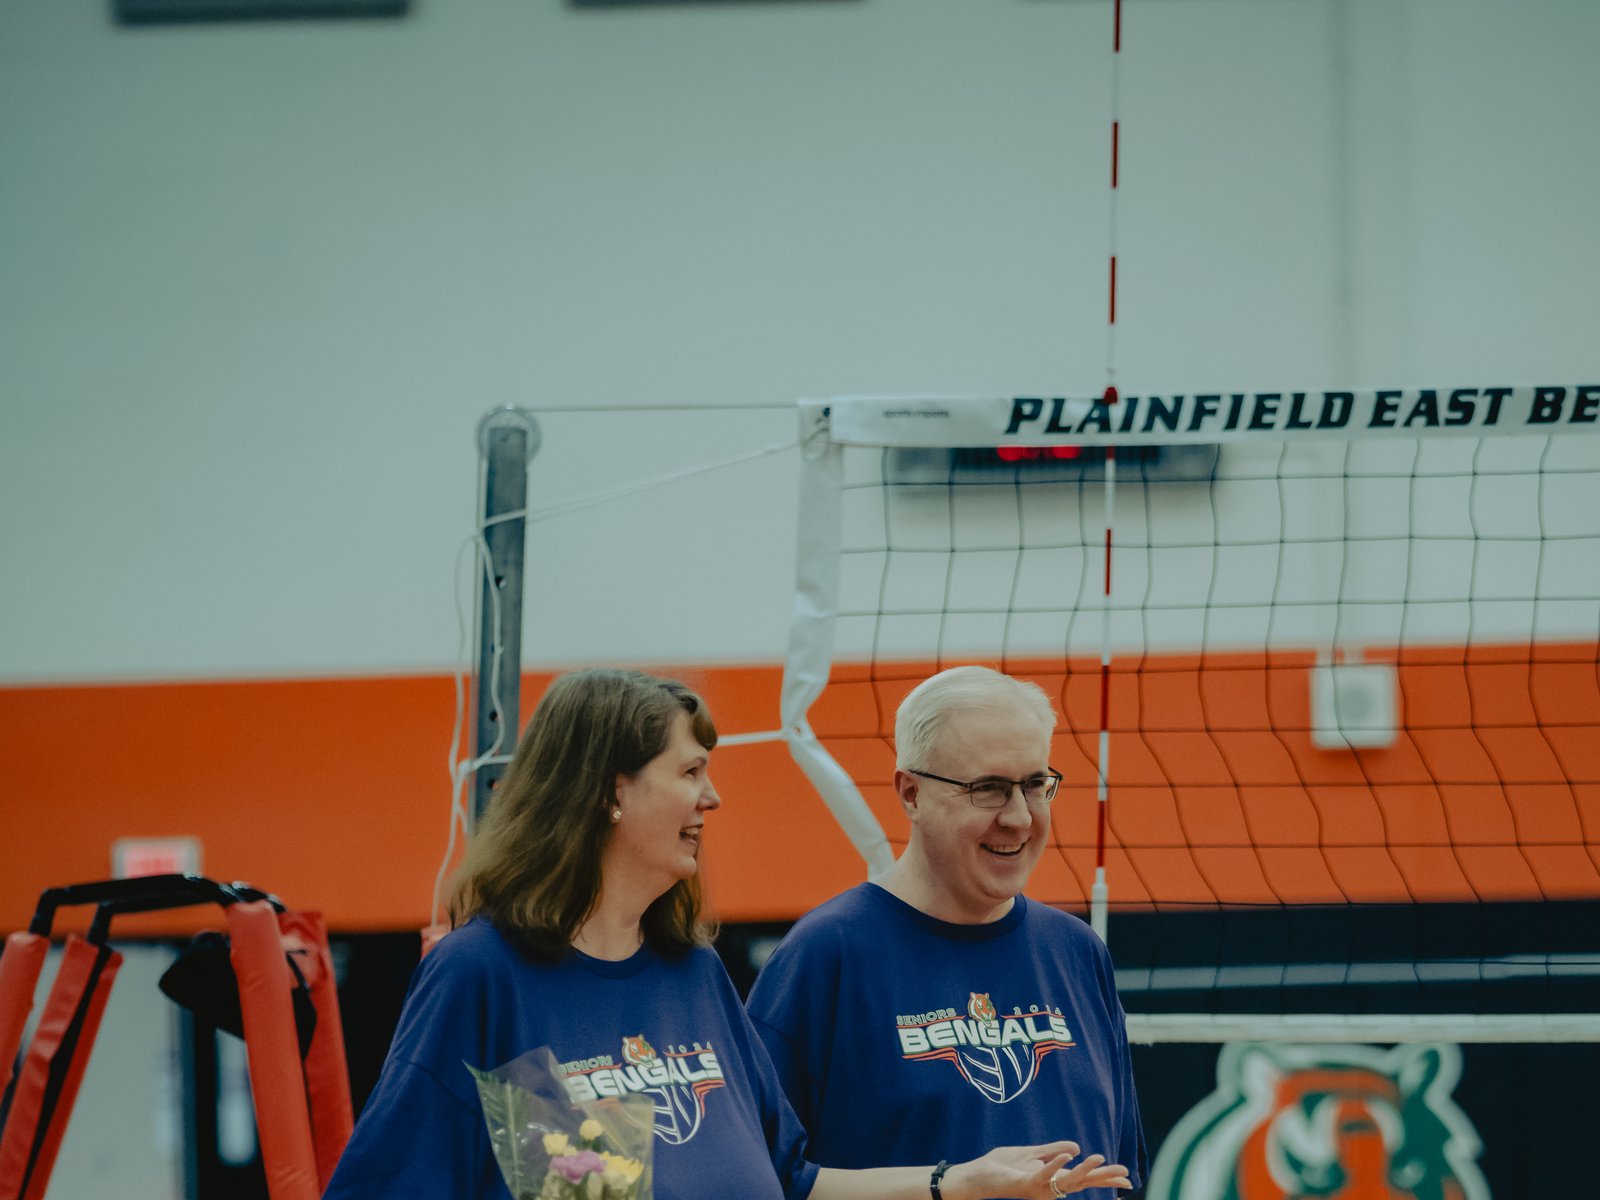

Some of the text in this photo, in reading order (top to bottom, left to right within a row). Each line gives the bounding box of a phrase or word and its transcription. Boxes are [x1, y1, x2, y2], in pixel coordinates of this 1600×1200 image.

[1005, 385, 1600, 433] PLAINFIELD EAST BE
[896, 1008, 957, 1026] SENIORS
[899, 1018, 1073, 1055] BENGALS
[568, 1052, 725, 1103] BENGALS
